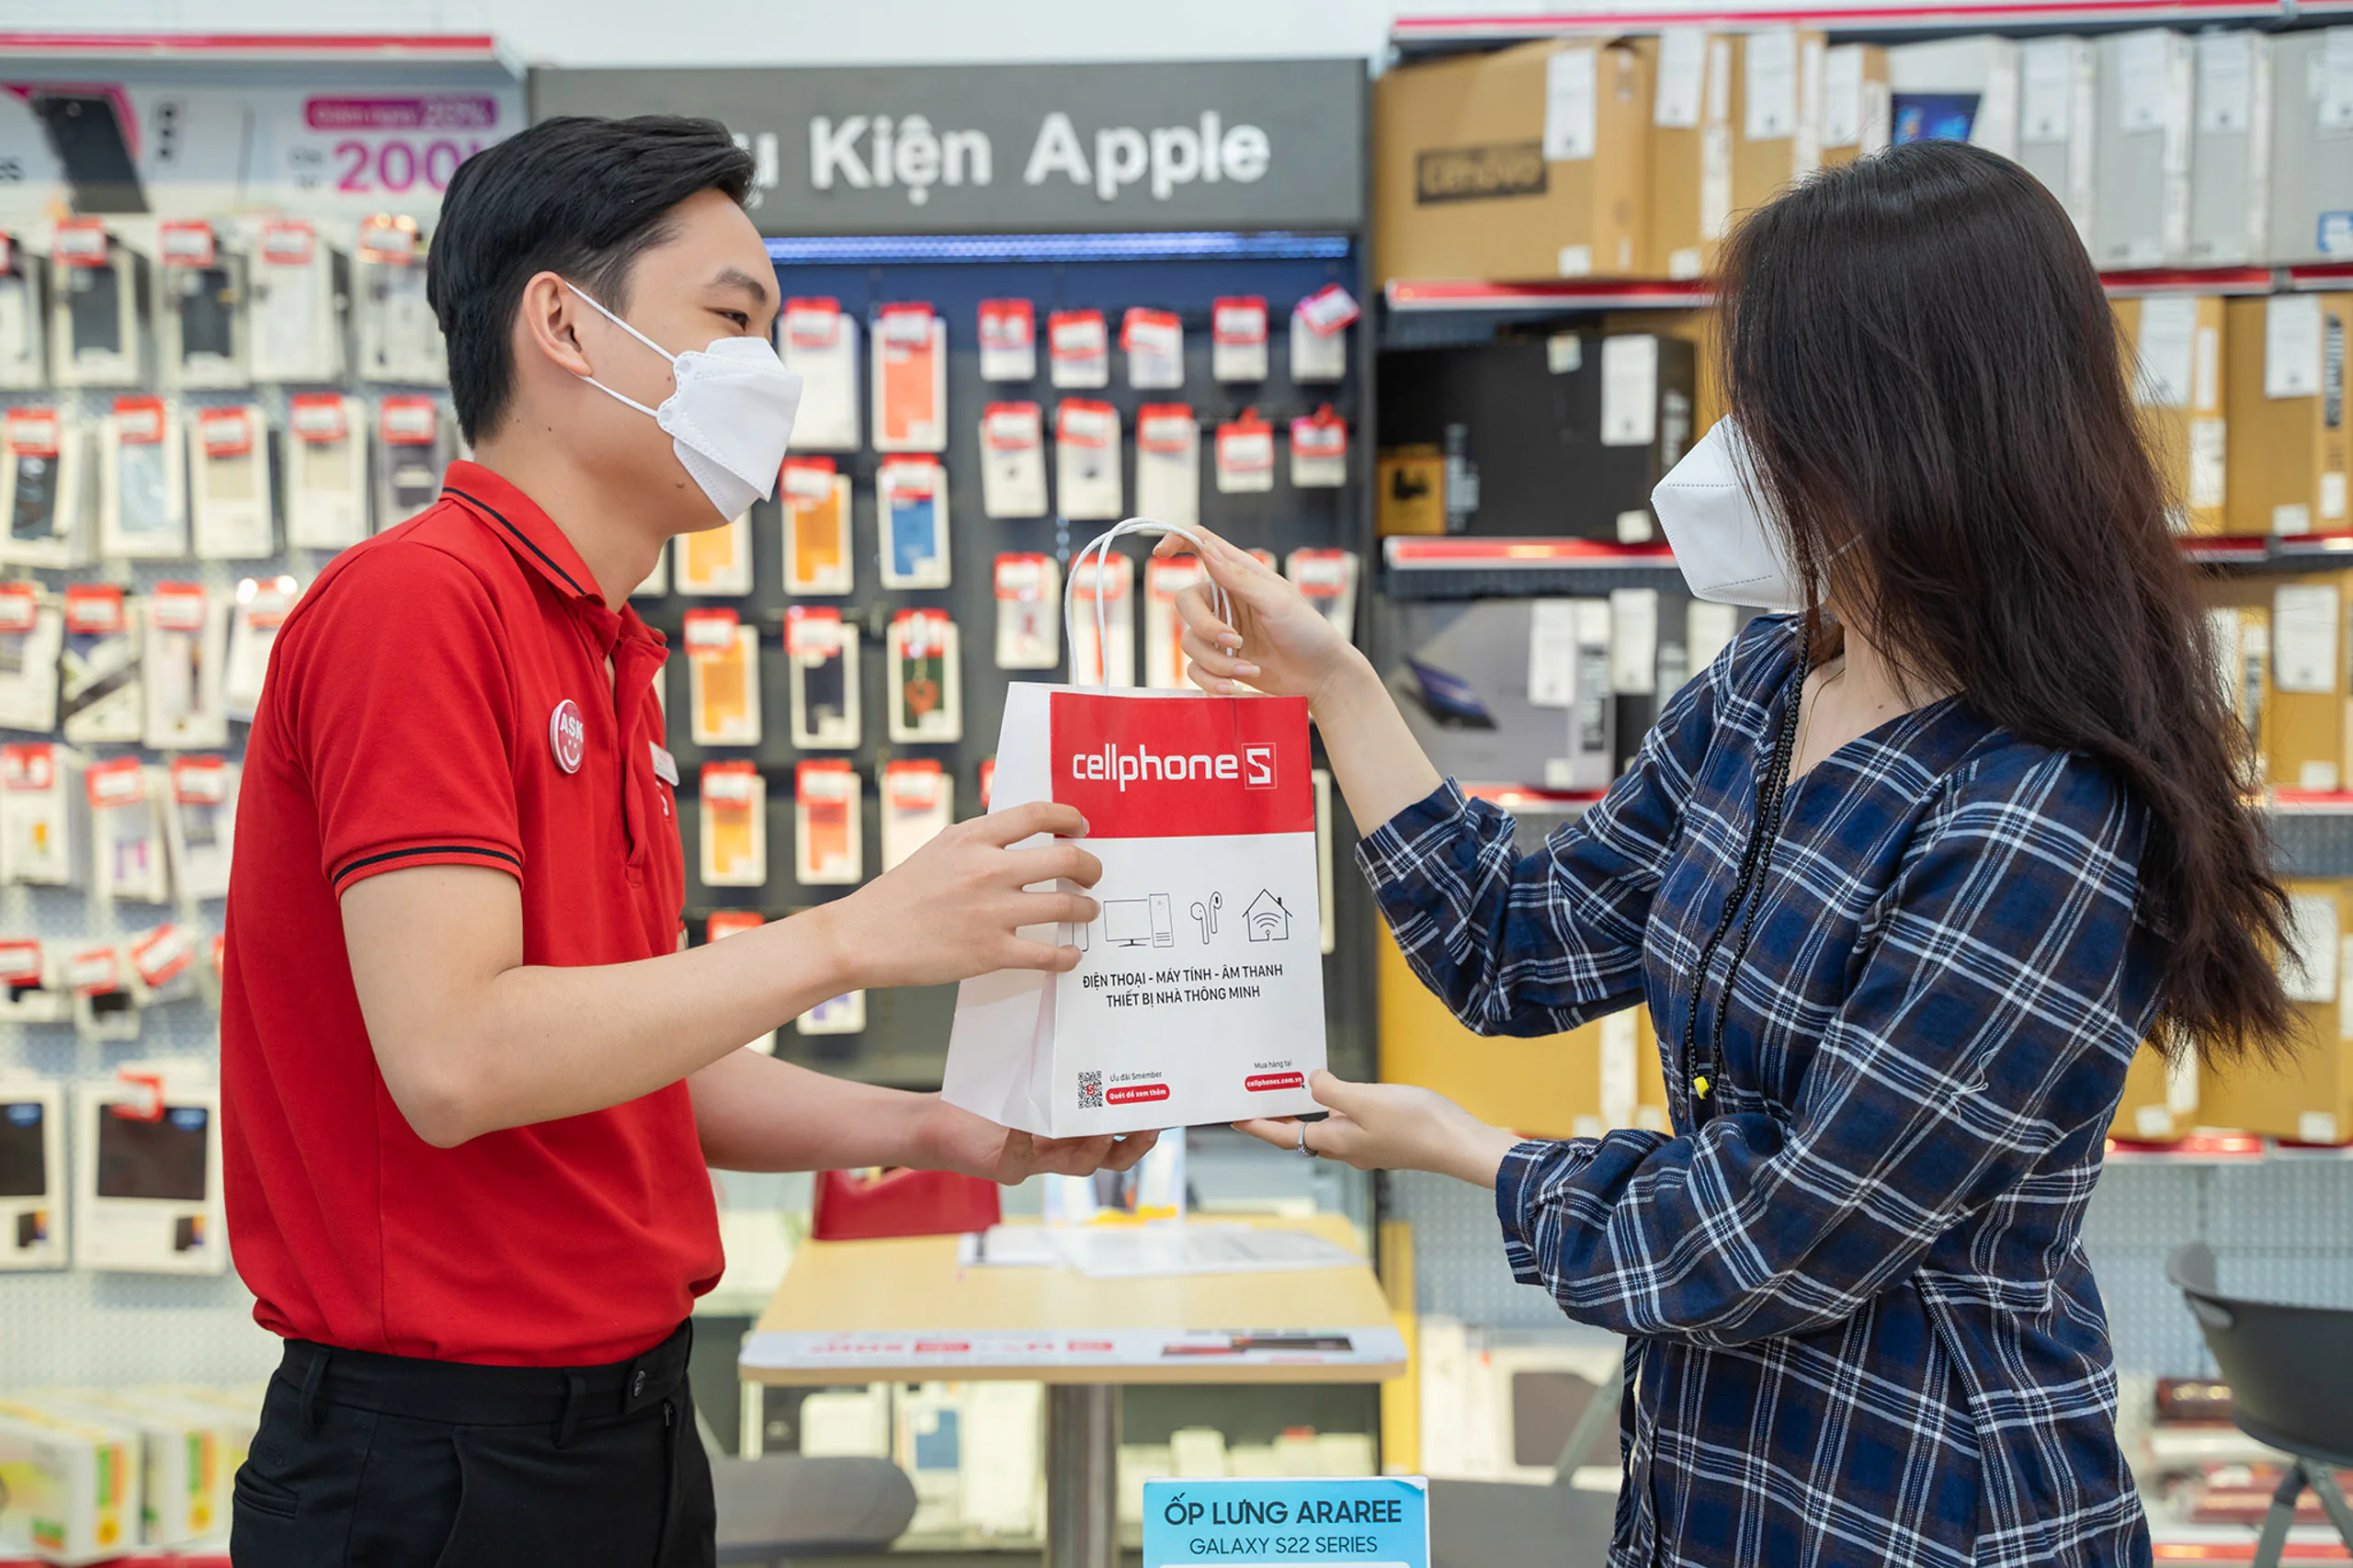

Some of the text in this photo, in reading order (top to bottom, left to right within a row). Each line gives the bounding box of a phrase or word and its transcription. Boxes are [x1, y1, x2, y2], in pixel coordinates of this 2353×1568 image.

[810, 114, 994, 207] Kiện
[1023, 110, 1272, 201] Apple
[560, 712, 585, 743] ASK
[1083, 971, 1108, 991] ĐIỆN
[1110, 971, 1146, 988] THOẠI
[1155, 968, 1181, 984] MÁY
[1183, 966, 1212, 983] TÍNH
[1222, 965, 1241, 980] ÂM
[1242, 963, 1284, 978] THANH
[1106, 985, 1261, 1008] THIẾT BỊ NHÀ THÔNG MINH
[1268, 1060, 1283, 1069] hàng
[1109, 1074, 1120, 1083] Ưu
[1131, 1070, 1163, 1081] Smember
[1246, 1076, 1302, 1087] cellphones.com.vn
[1108, 1091, 1126, 1100] Quét
[1126, 1090, 1135, 1099] để
[1150, 1088, 1167, 1096] thêm
[1164, 1492, 1403, 1526] ỐP LƯNG ARAREE
[1189, 1536, 1378, 1555] GALAXY S22 SERIES
